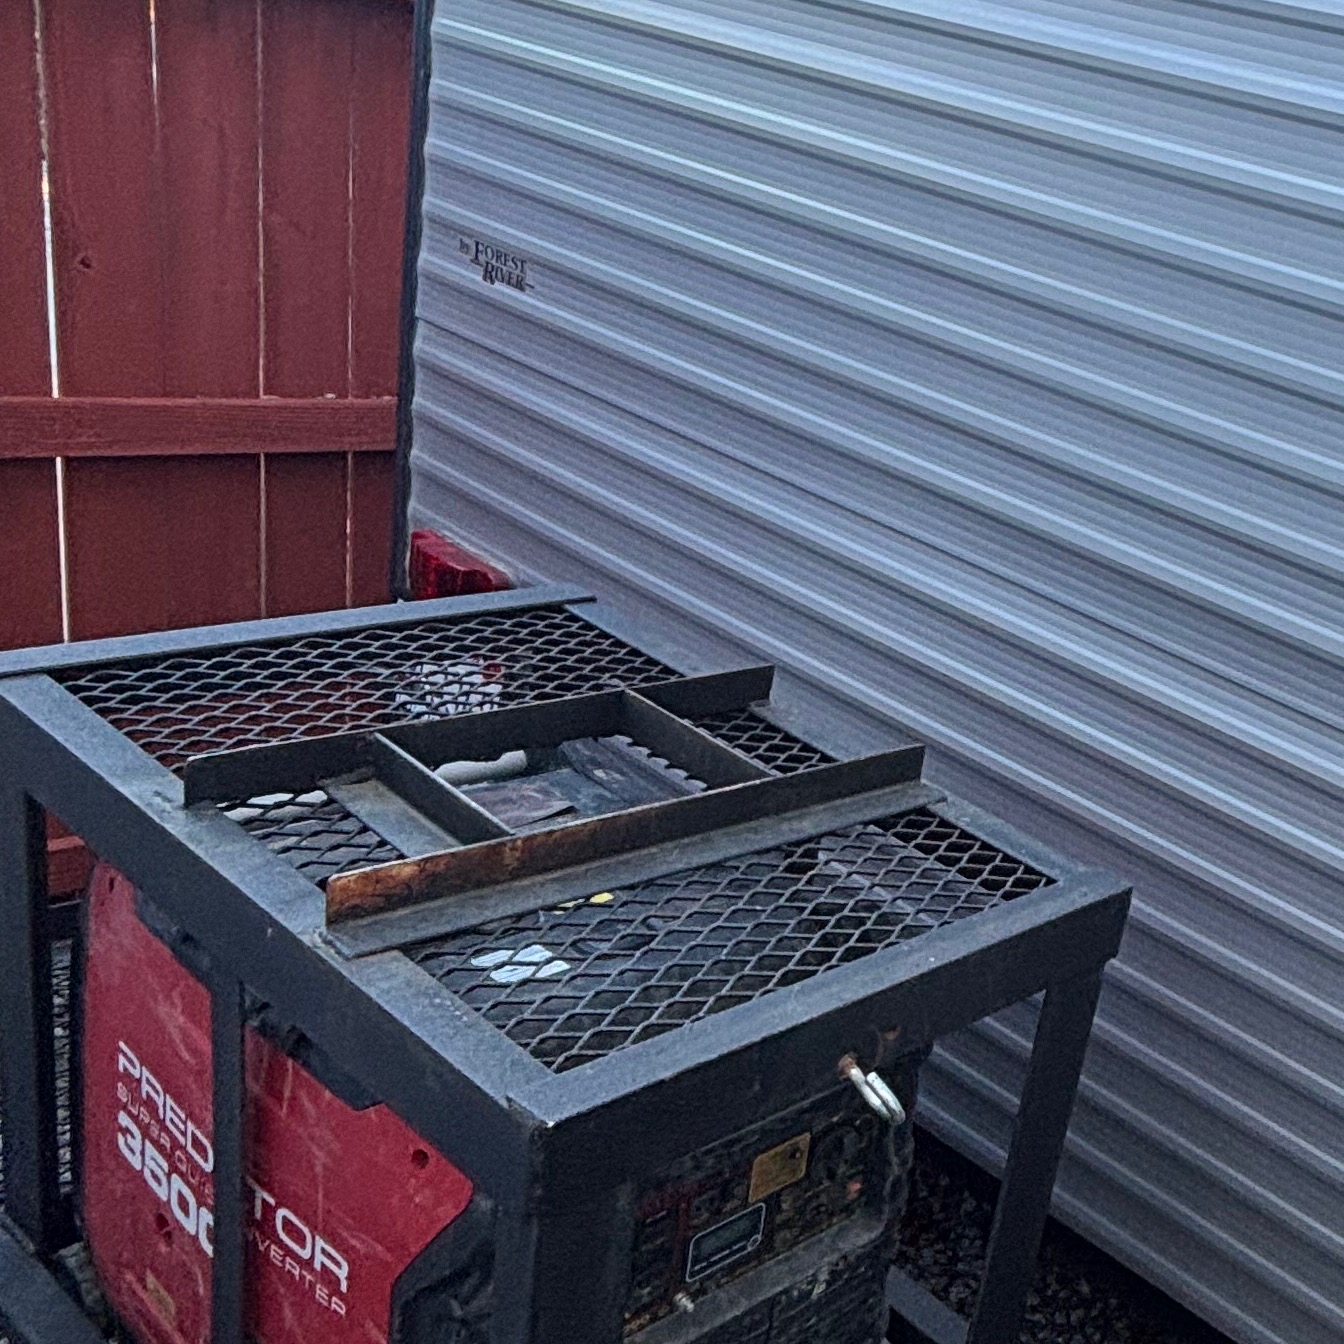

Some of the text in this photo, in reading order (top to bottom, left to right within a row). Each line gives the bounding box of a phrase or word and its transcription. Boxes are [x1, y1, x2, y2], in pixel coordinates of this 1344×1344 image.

[471, 239, 527, 274] FOREST
[482, 261, 527, 293] RIVER
[117, 1040, 349, 1294] PREDTOR
